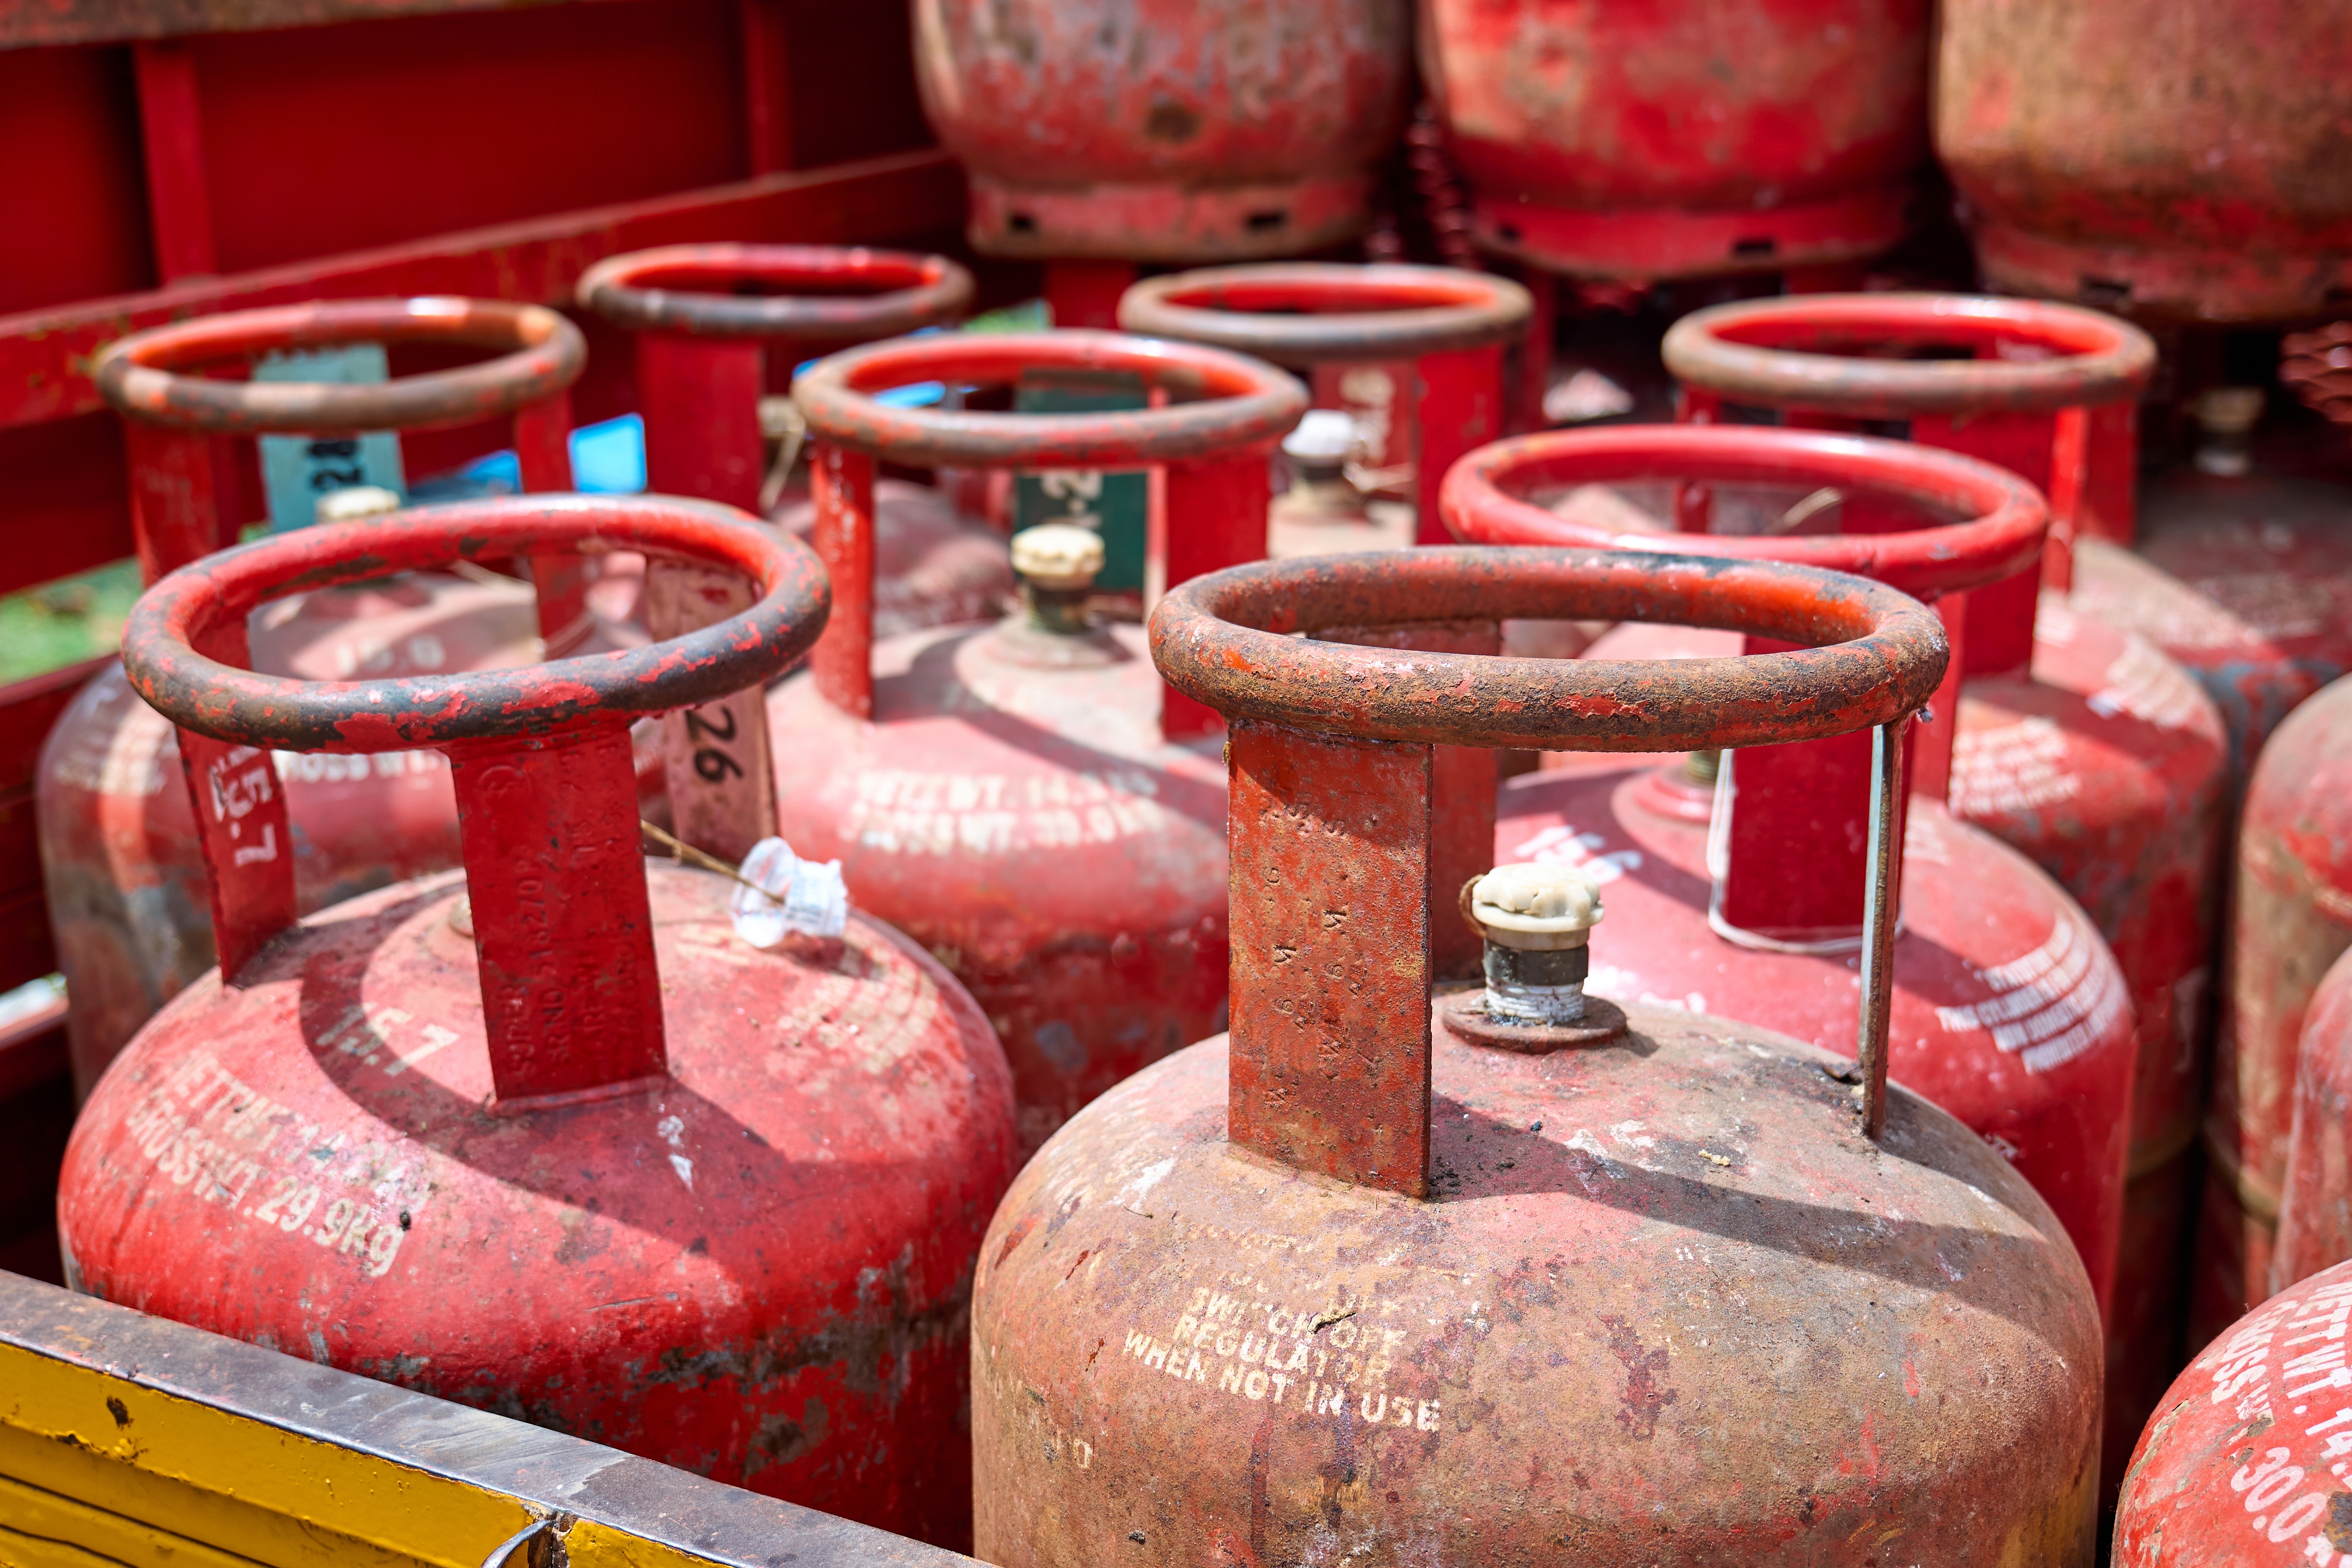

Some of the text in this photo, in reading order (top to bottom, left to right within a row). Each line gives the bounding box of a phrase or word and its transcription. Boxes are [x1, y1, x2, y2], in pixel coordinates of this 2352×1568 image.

[316, 1001, 460, 1078] 15.7
[257, 1174, 405, 1278] 29.9kg
[1122, 1328, 1441, 1433] WHEN NOT IN USE
